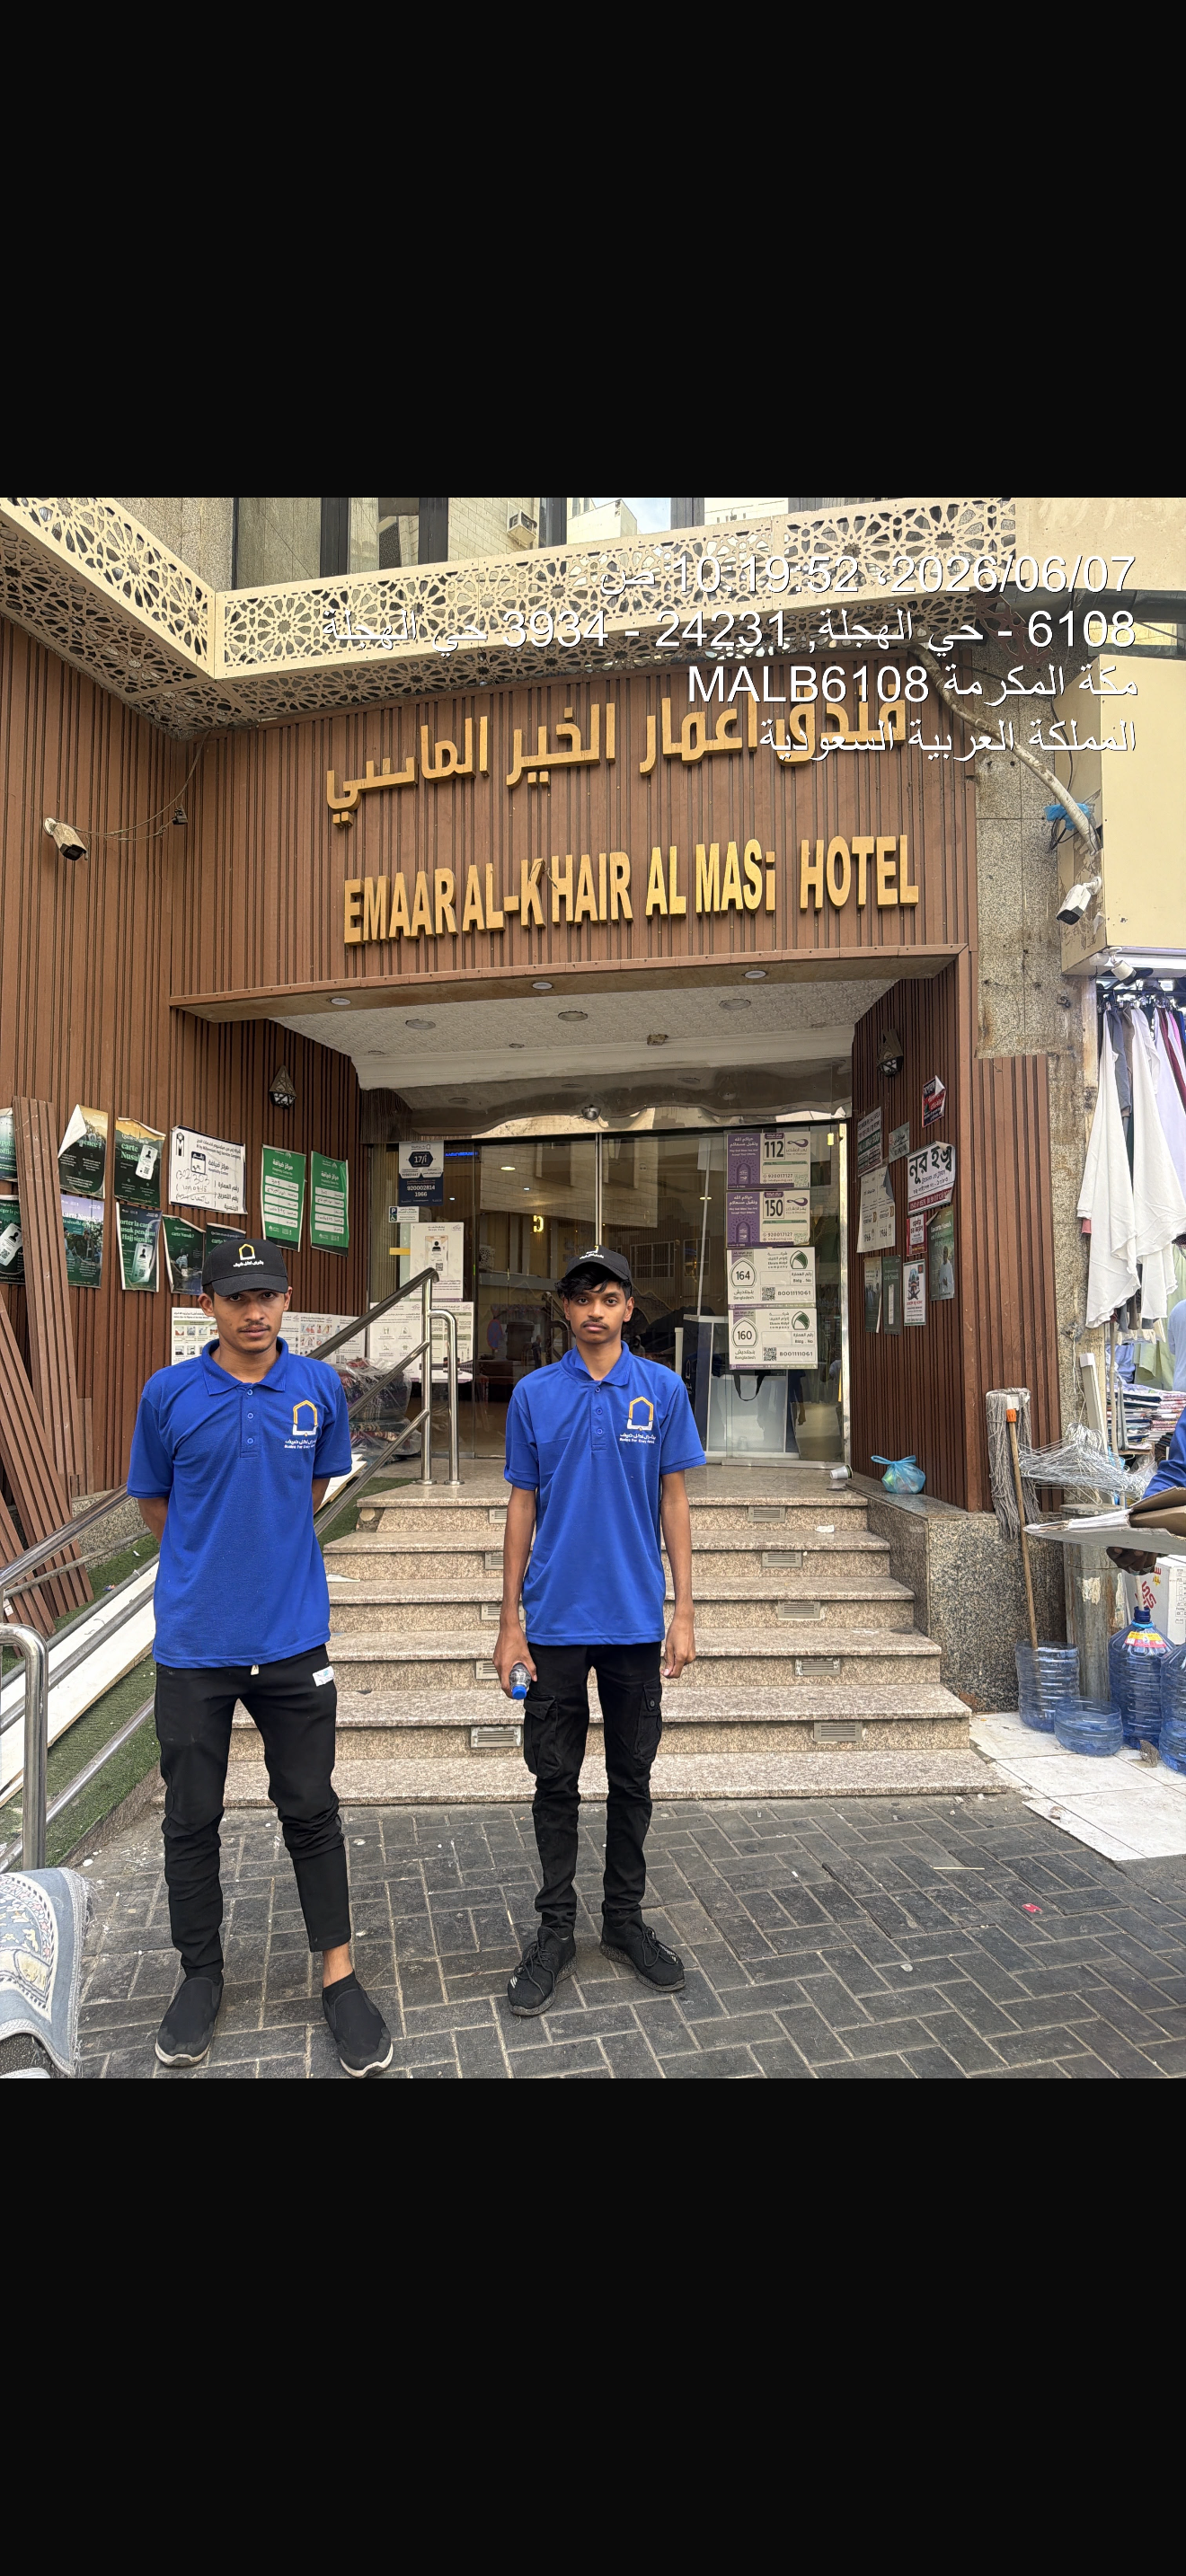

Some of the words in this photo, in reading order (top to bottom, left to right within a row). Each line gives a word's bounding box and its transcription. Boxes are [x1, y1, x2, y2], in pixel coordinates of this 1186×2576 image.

[775, 684, 907, 767] فندق
[506, 702, 616, 790] الخير
[326, 716, 490, 828] الماسي
[344, 867, 459, 946] EMAAR
[645, 846, 686, 920] AL
[800, 834, 919, 913] HOTEL
[120, 1142, 139, 1152] carte
[764, 1140, 784, 1159] 112
[765, 1199, 783, 1217] 150
[121, 1226, 134, 1234] usuk
[735, 1270, 751, 1281] 164
[737, 1330, 753, 1340] 160
